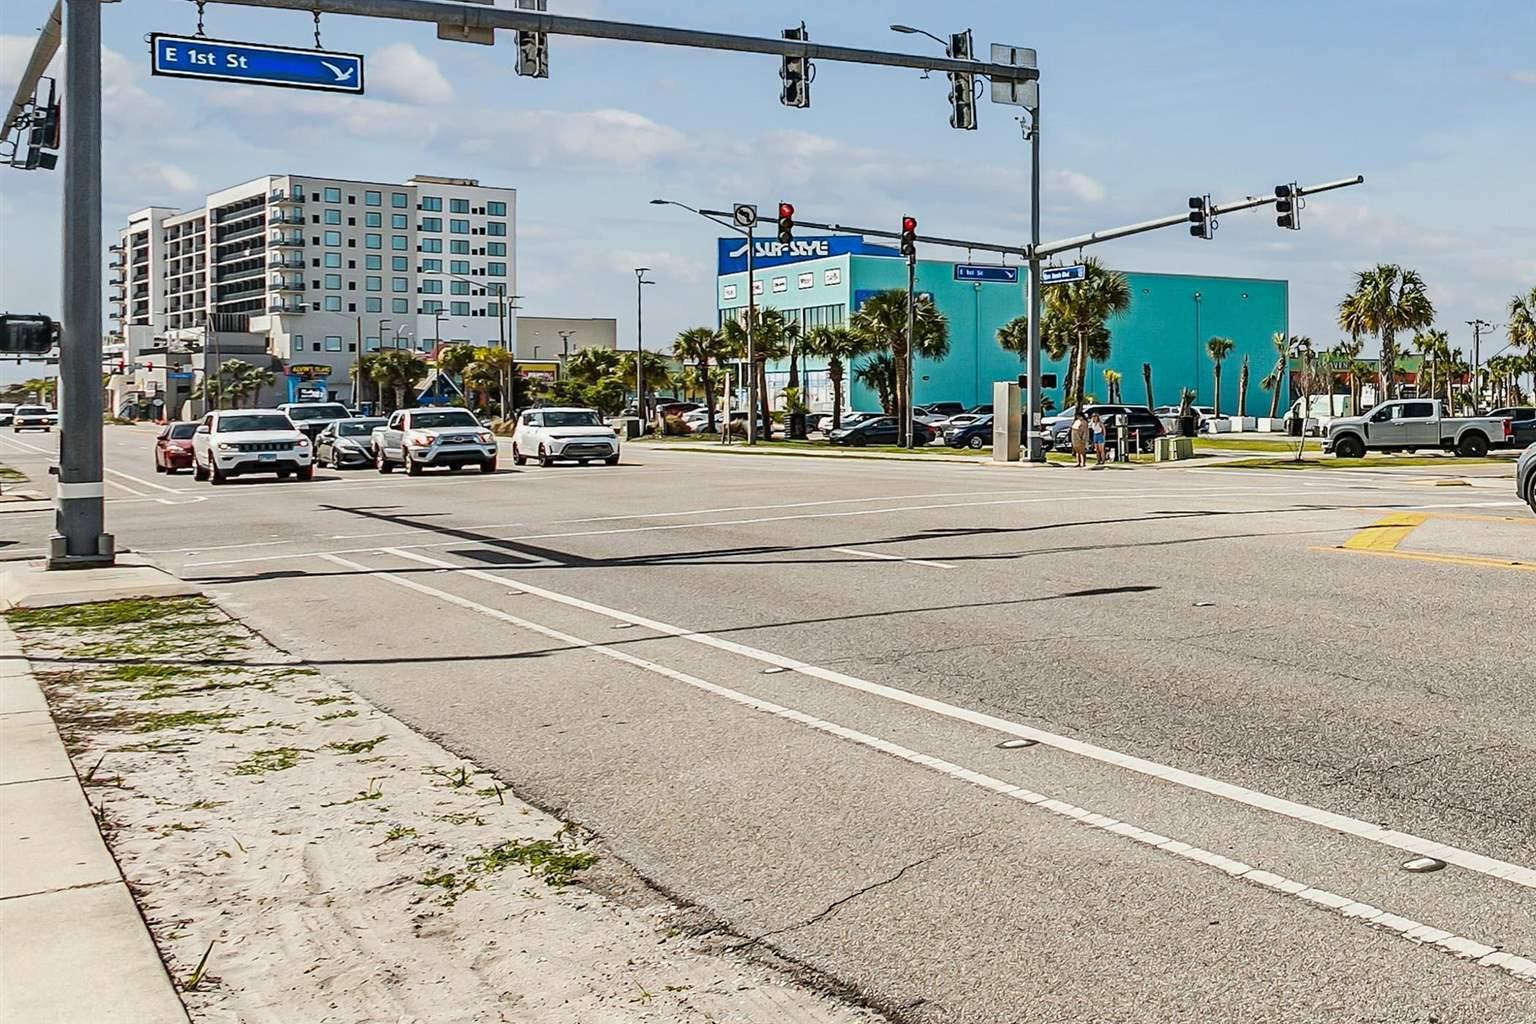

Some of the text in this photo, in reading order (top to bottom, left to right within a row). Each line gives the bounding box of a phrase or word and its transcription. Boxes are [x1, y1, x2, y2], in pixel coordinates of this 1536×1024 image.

[165, 47, 248, 68] E 1st St
